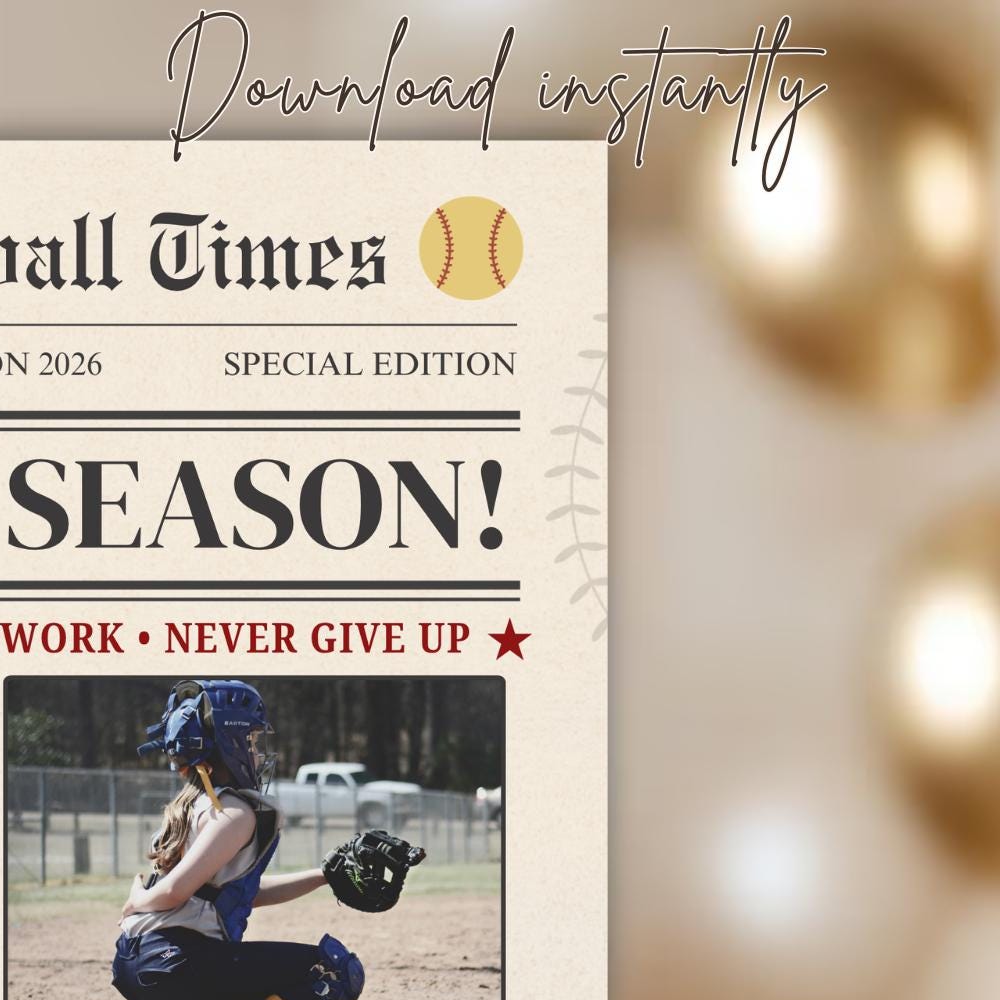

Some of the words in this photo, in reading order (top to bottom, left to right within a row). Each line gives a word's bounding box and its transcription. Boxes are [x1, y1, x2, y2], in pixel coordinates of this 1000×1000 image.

[149, 211, 386, 291] Times
[38, 352, 101, 376] 2026
[224, 351, 363, 377] SPECIAL
[373, 351, 516, 377] EDITION
[8, 458, 503, 551] SEASON!
[165, 621, 297, 654] NEVER
[310, 621, 405, 654] GIVE
[419, 621, 470, 654] UP
